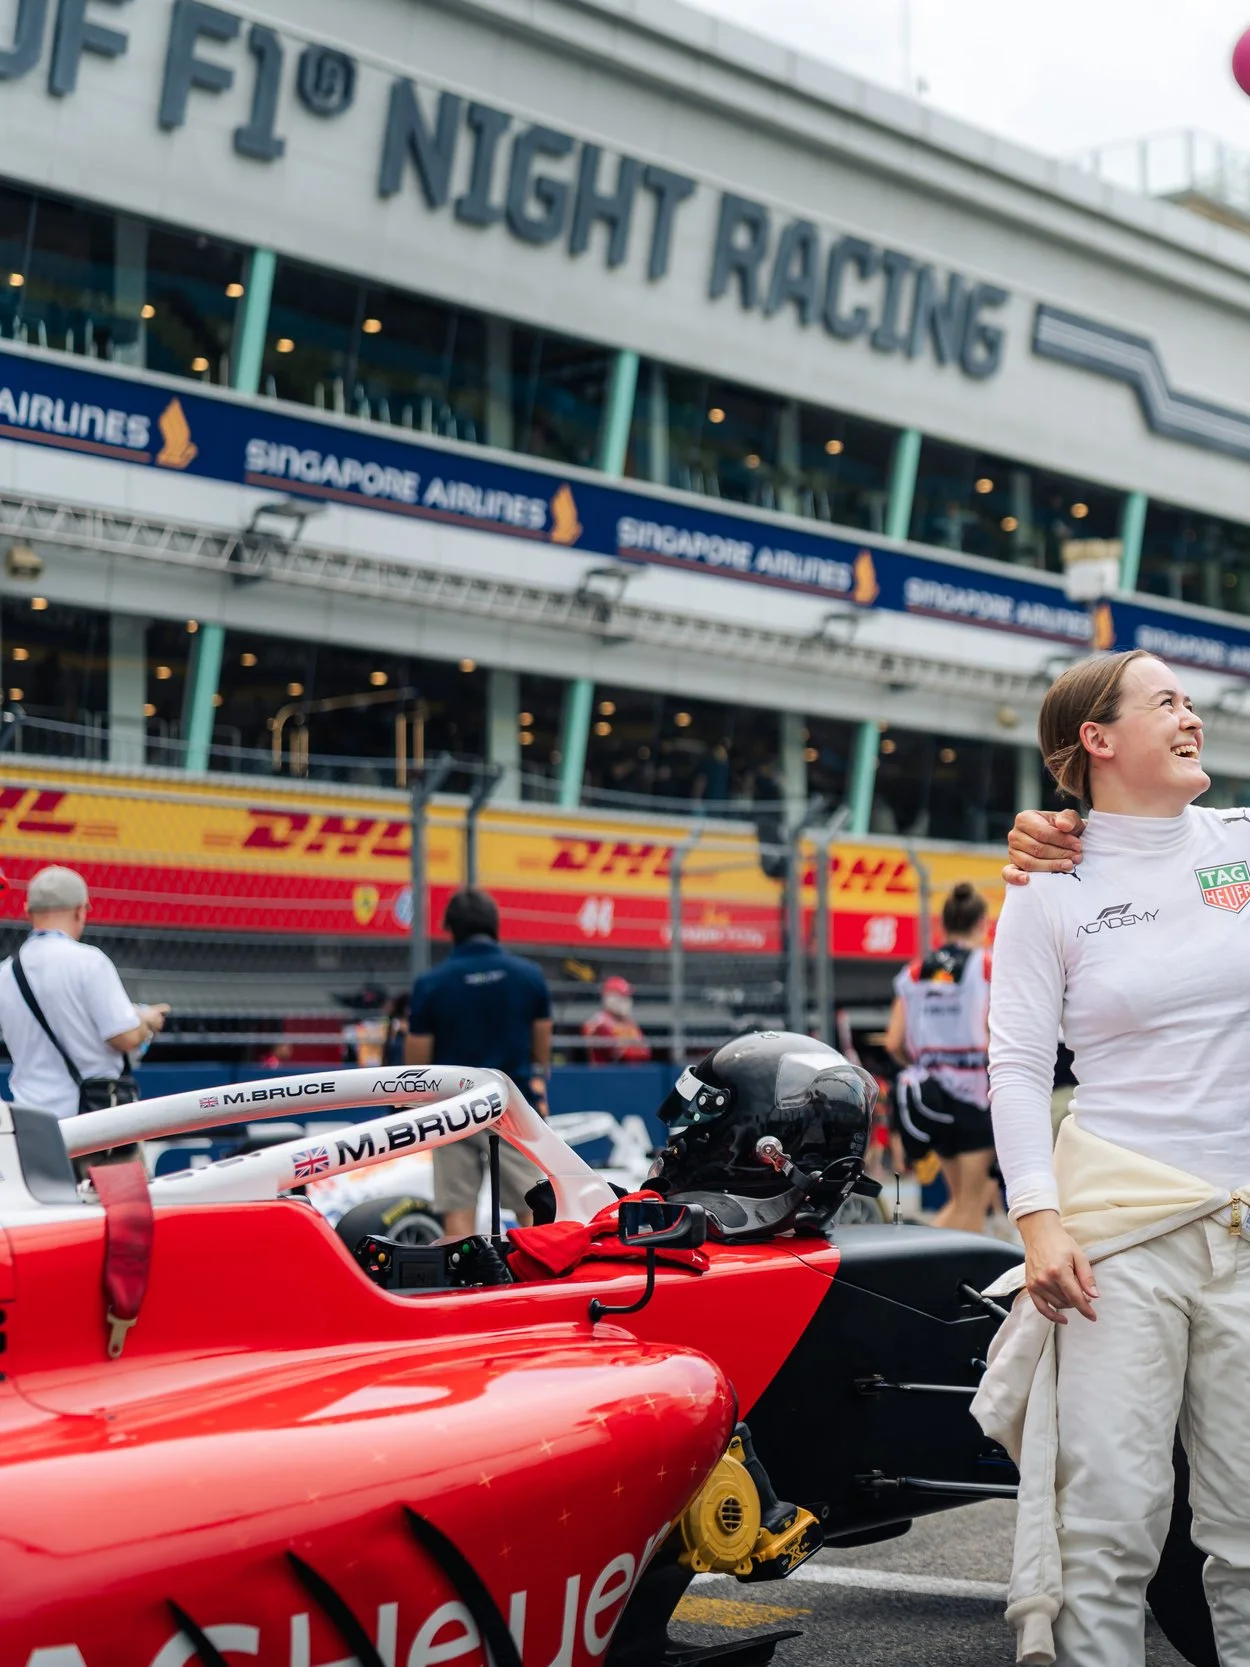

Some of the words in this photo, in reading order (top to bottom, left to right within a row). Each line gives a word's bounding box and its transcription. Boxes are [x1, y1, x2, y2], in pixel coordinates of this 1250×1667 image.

[378, 77, 696, 282] NIGHT
[708, 190, 1011, 381] RACING
[0, 386, 151, 449] AIRLINES
[244, 438, 421, 505] SINGAPORE
[422, 476, 547, 531] AIRLINES
[617, 515, 754, 573] SINGAPORE
[755, 546, 852, 593] AIRLINES
[243, 810, 412, 858] DHL
[550, 836, 675, 877] DHL
[1201, 866, 1246, 887] TAG
[1076, 909, 1160, 938] ACADEMY
[223, 1081, 336, 1105] M.BRUCE
[372, 1078, 443, 1093] ACADEMY
[334, 1092, 502, 1167] M.BRUCE
